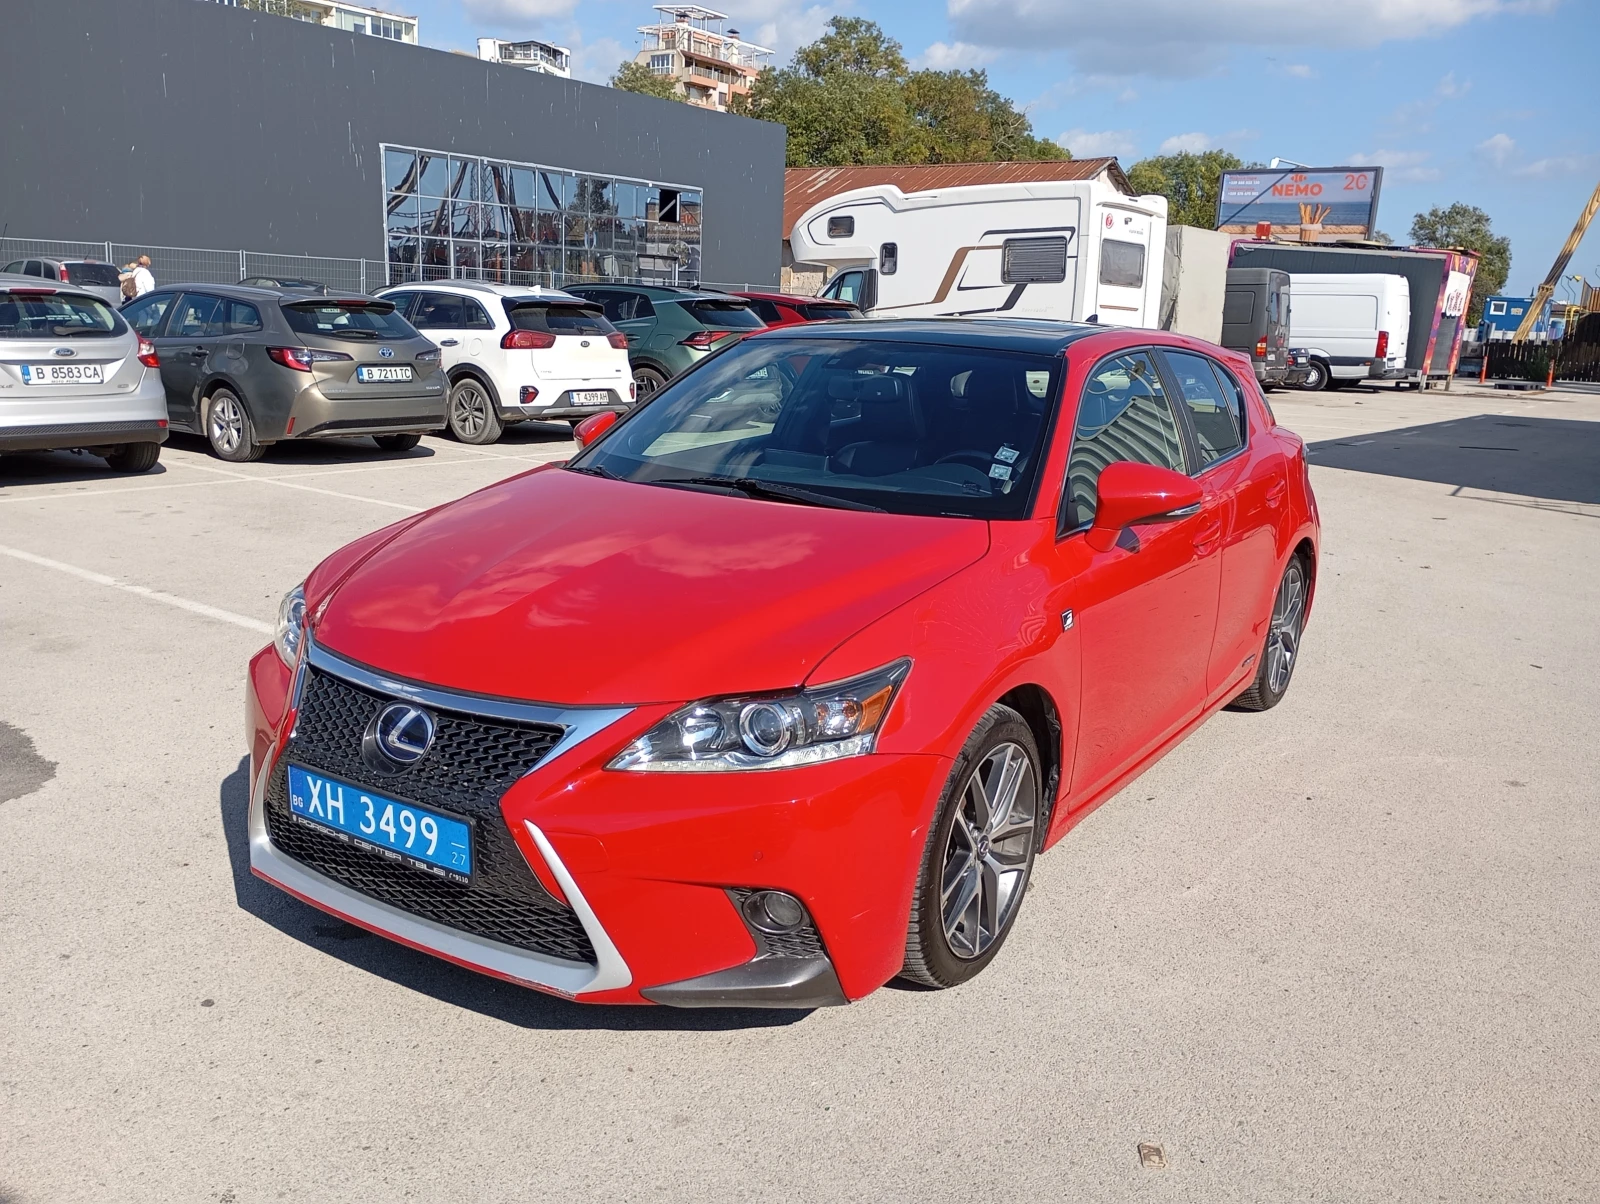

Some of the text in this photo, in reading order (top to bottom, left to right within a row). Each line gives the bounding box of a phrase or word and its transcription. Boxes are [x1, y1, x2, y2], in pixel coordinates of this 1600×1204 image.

[1272, 183, 1323, 197] NEMO
[36, 367, 100, 380] B 8583 CA
[366, 368, 411, 379] B 7211 TC
[576, 393, 581, 402] T
[584, 392, 599, 402] 4399
[292, 794, 304, 808] BG
[306, 775, 438, 856] XH 3499
[298, 817, 349, 842] PORSCHE
[354, 838, 402, 861] CENTER
[407, 857, 446, 877] TBILISI
[451, 851, 466, 866] 27
